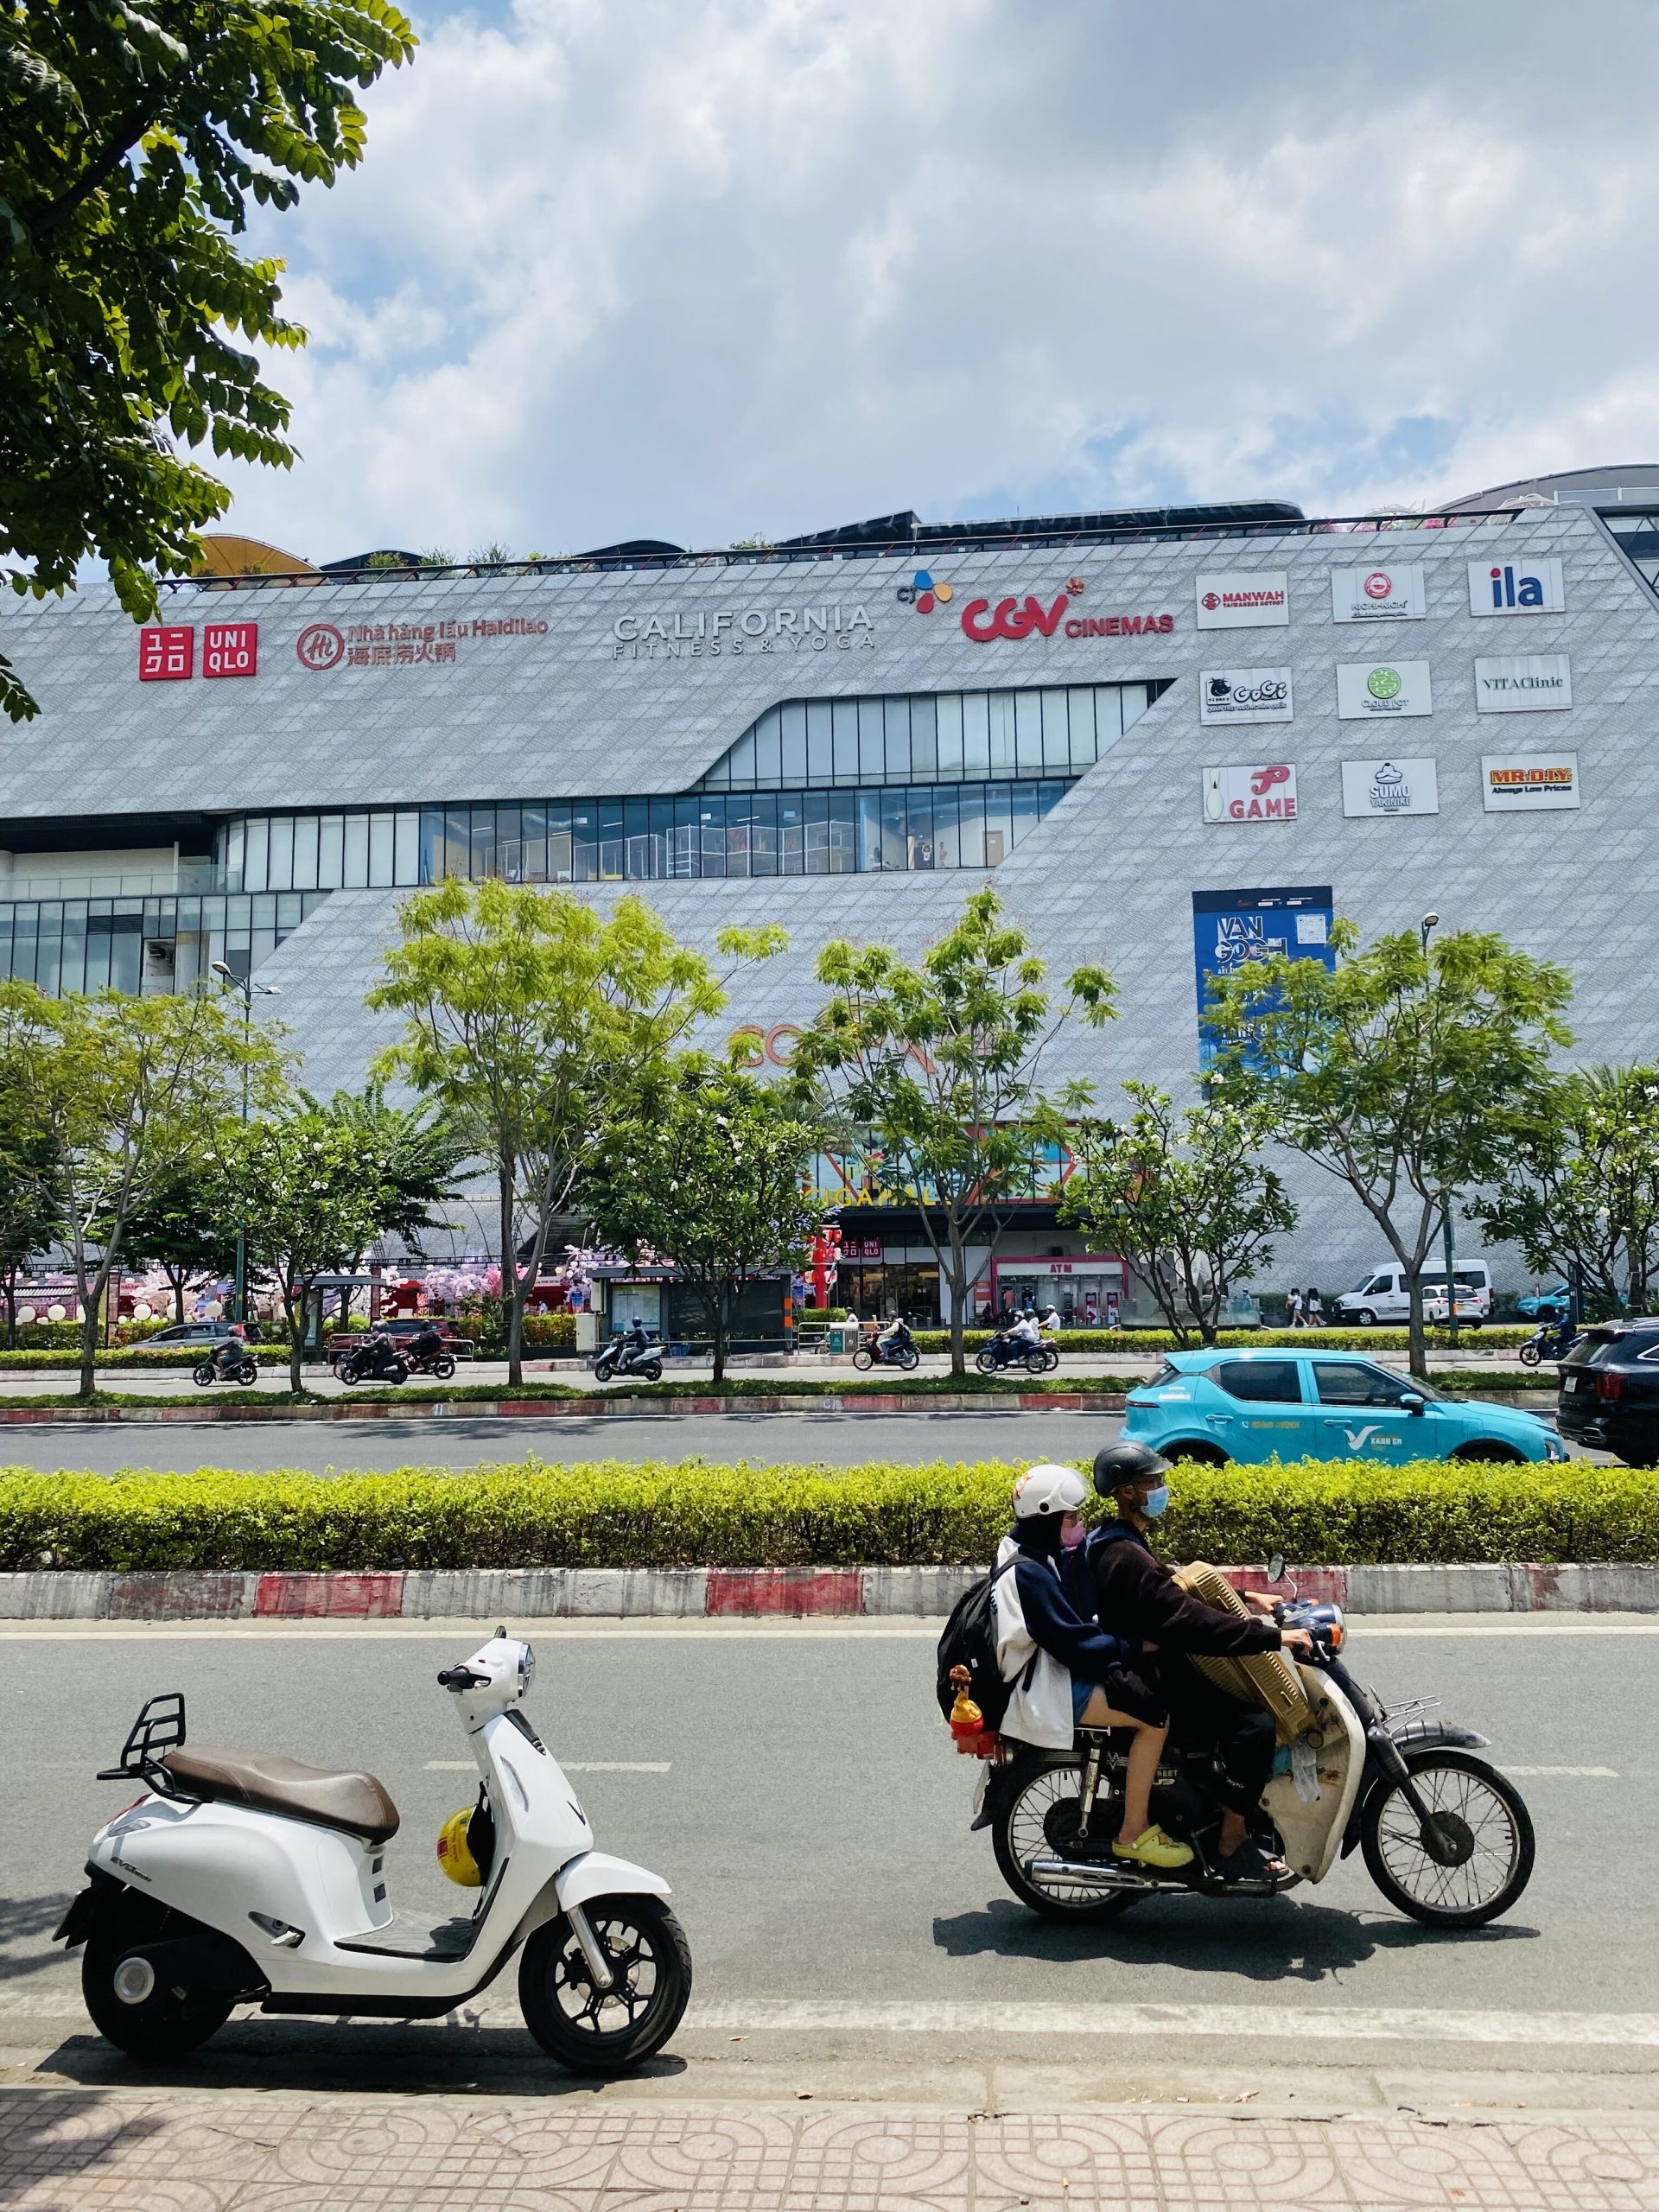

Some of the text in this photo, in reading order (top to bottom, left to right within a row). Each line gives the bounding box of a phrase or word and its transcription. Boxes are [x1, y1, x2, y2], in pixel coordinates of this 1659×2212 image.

[1223, 590, 1284, 602] MANWAH
[1491, 566, 1543, 607] ila
[473, 618, 550, 637] Haidilao
[613, 606, 874, 642] CALIFORNIA
[961, 594, 1174, 642] CGV CINEMAS
[613, 633, 875, 660] FITNESS & YOGA
[1234, 679, 1287, 703] GoGi
[1370, 785, 1411, 799] SUMO
[1229, 798, 1296, 819] GAME
[1217, 916, 1263, 940] VAN
[1050, 1264, 1072, 1274] ATM
